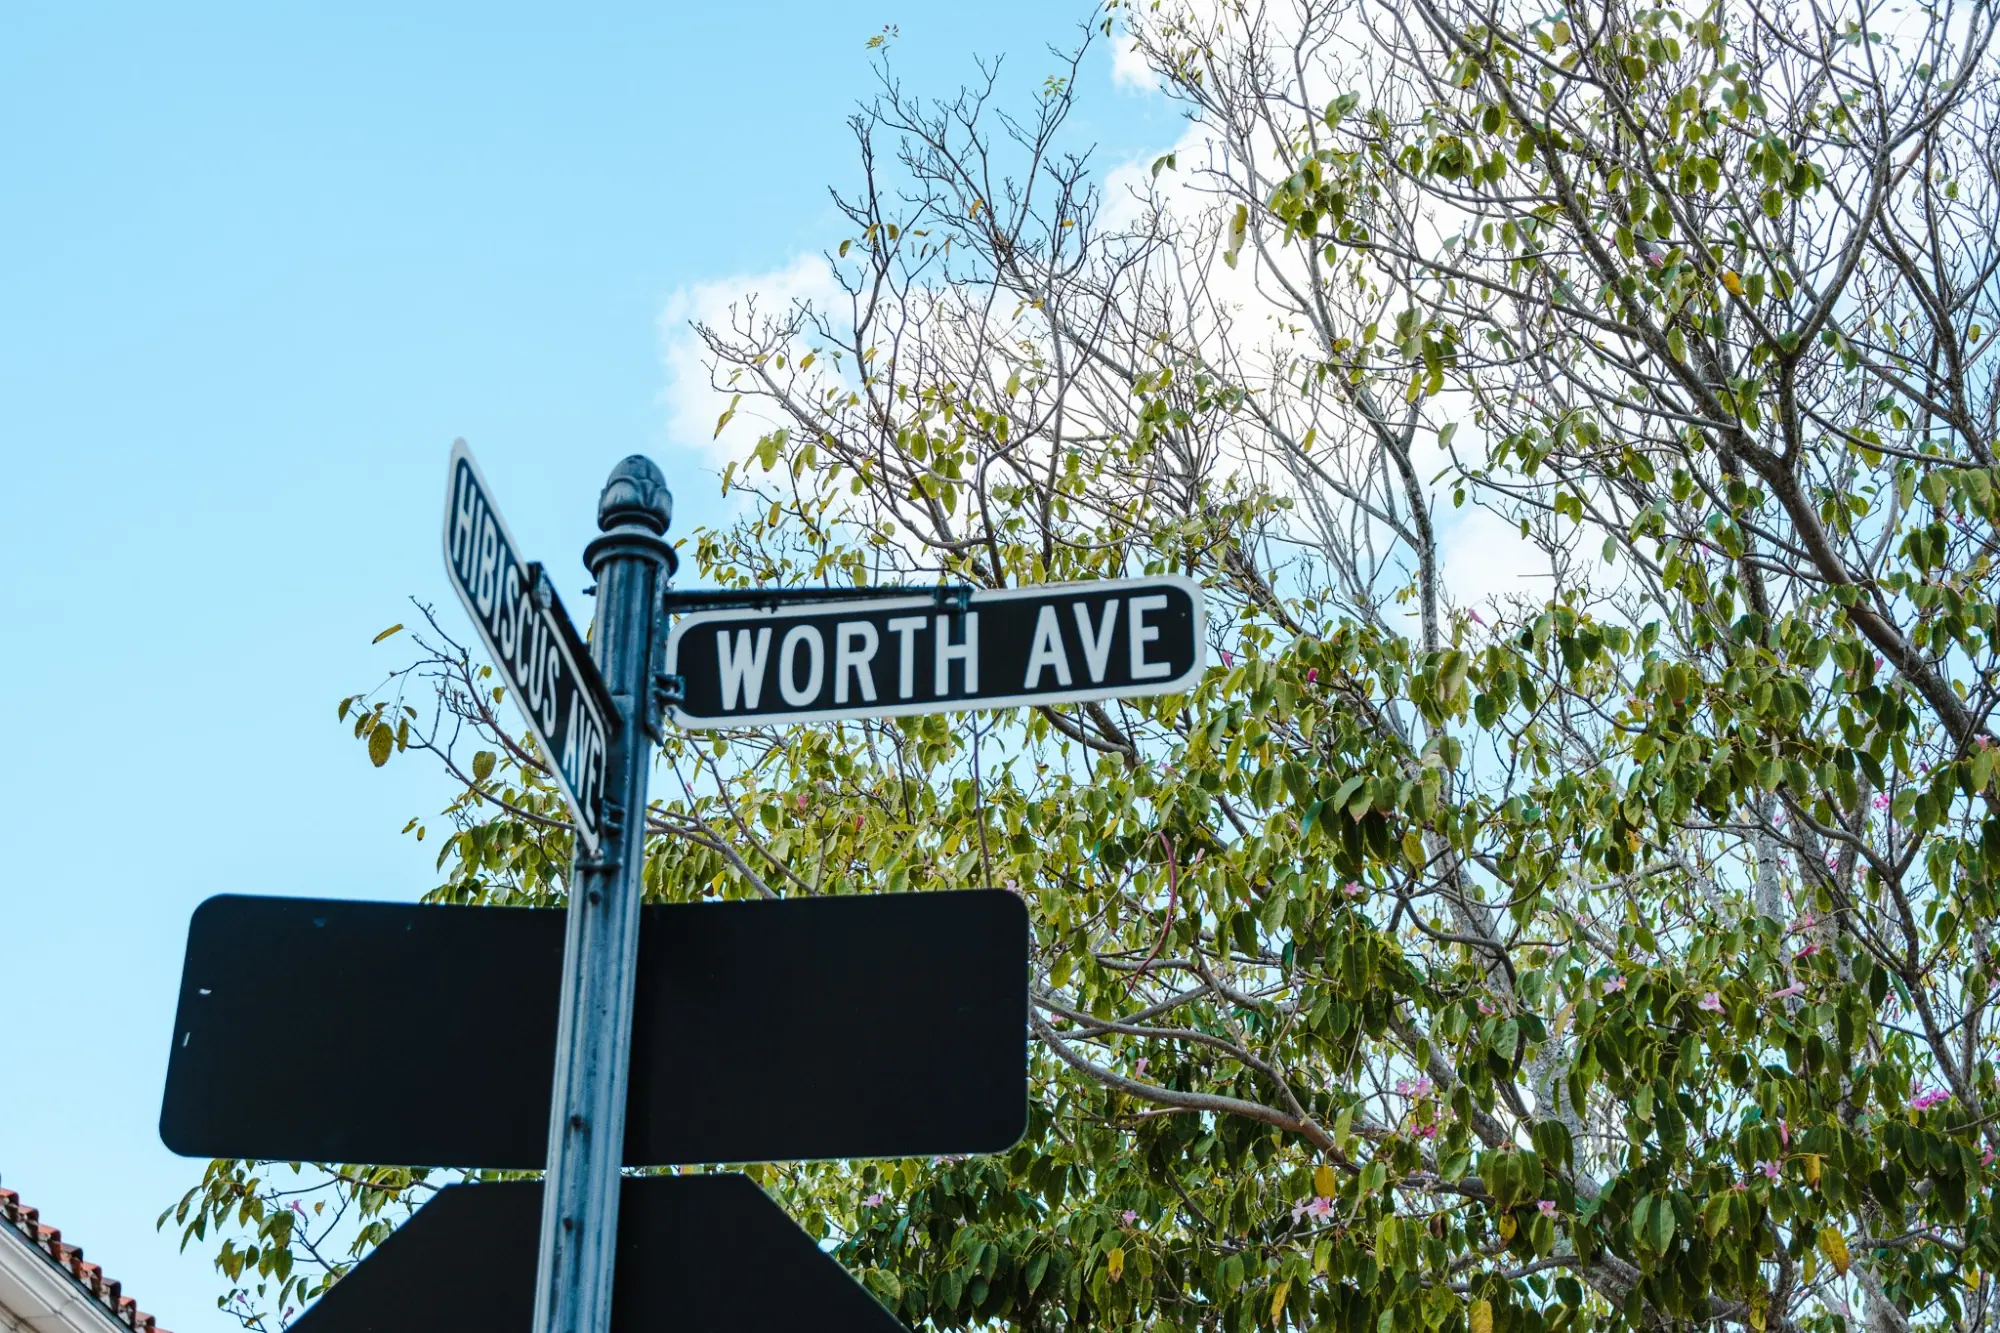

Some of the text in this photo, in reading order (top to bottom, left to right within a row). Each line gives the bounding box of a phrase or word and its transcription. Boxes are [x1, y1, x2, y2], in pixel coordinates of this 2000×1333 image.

[454, 467, 600, 825] HIBISCUS AVE
[716, 594, 1171, 711] WORTH AVE
